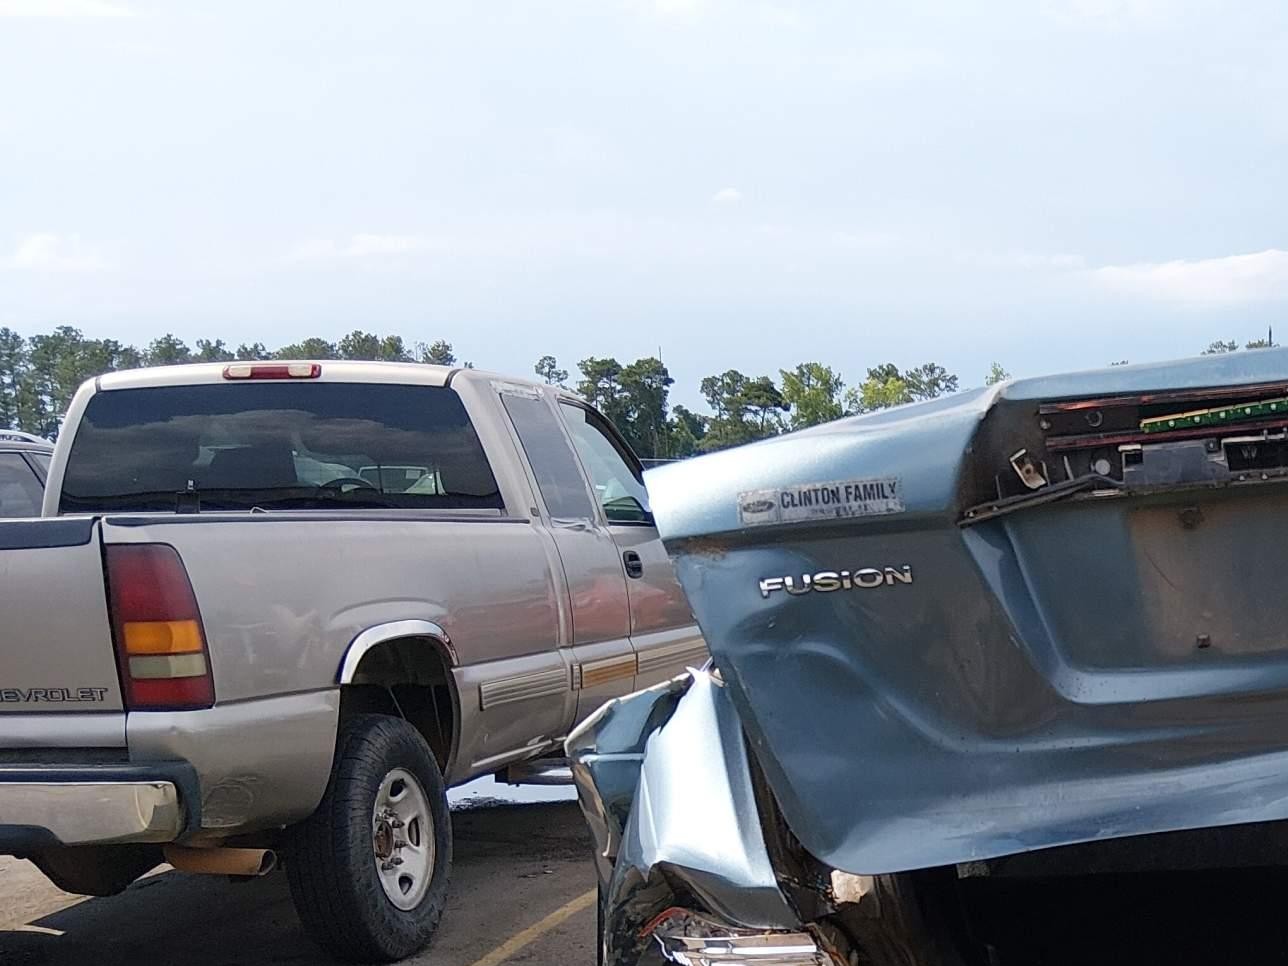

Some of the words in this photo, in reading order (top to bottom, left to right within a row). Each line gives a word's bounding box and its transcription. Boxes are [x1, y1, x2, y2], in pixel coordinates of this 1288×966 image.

[780, 486, 841, 509] CLINTON
[844, 481, 897, 503] FAMILY
[759, 565, 913, 598] FUSION
[0, 687, 108, 702] EVROLET
